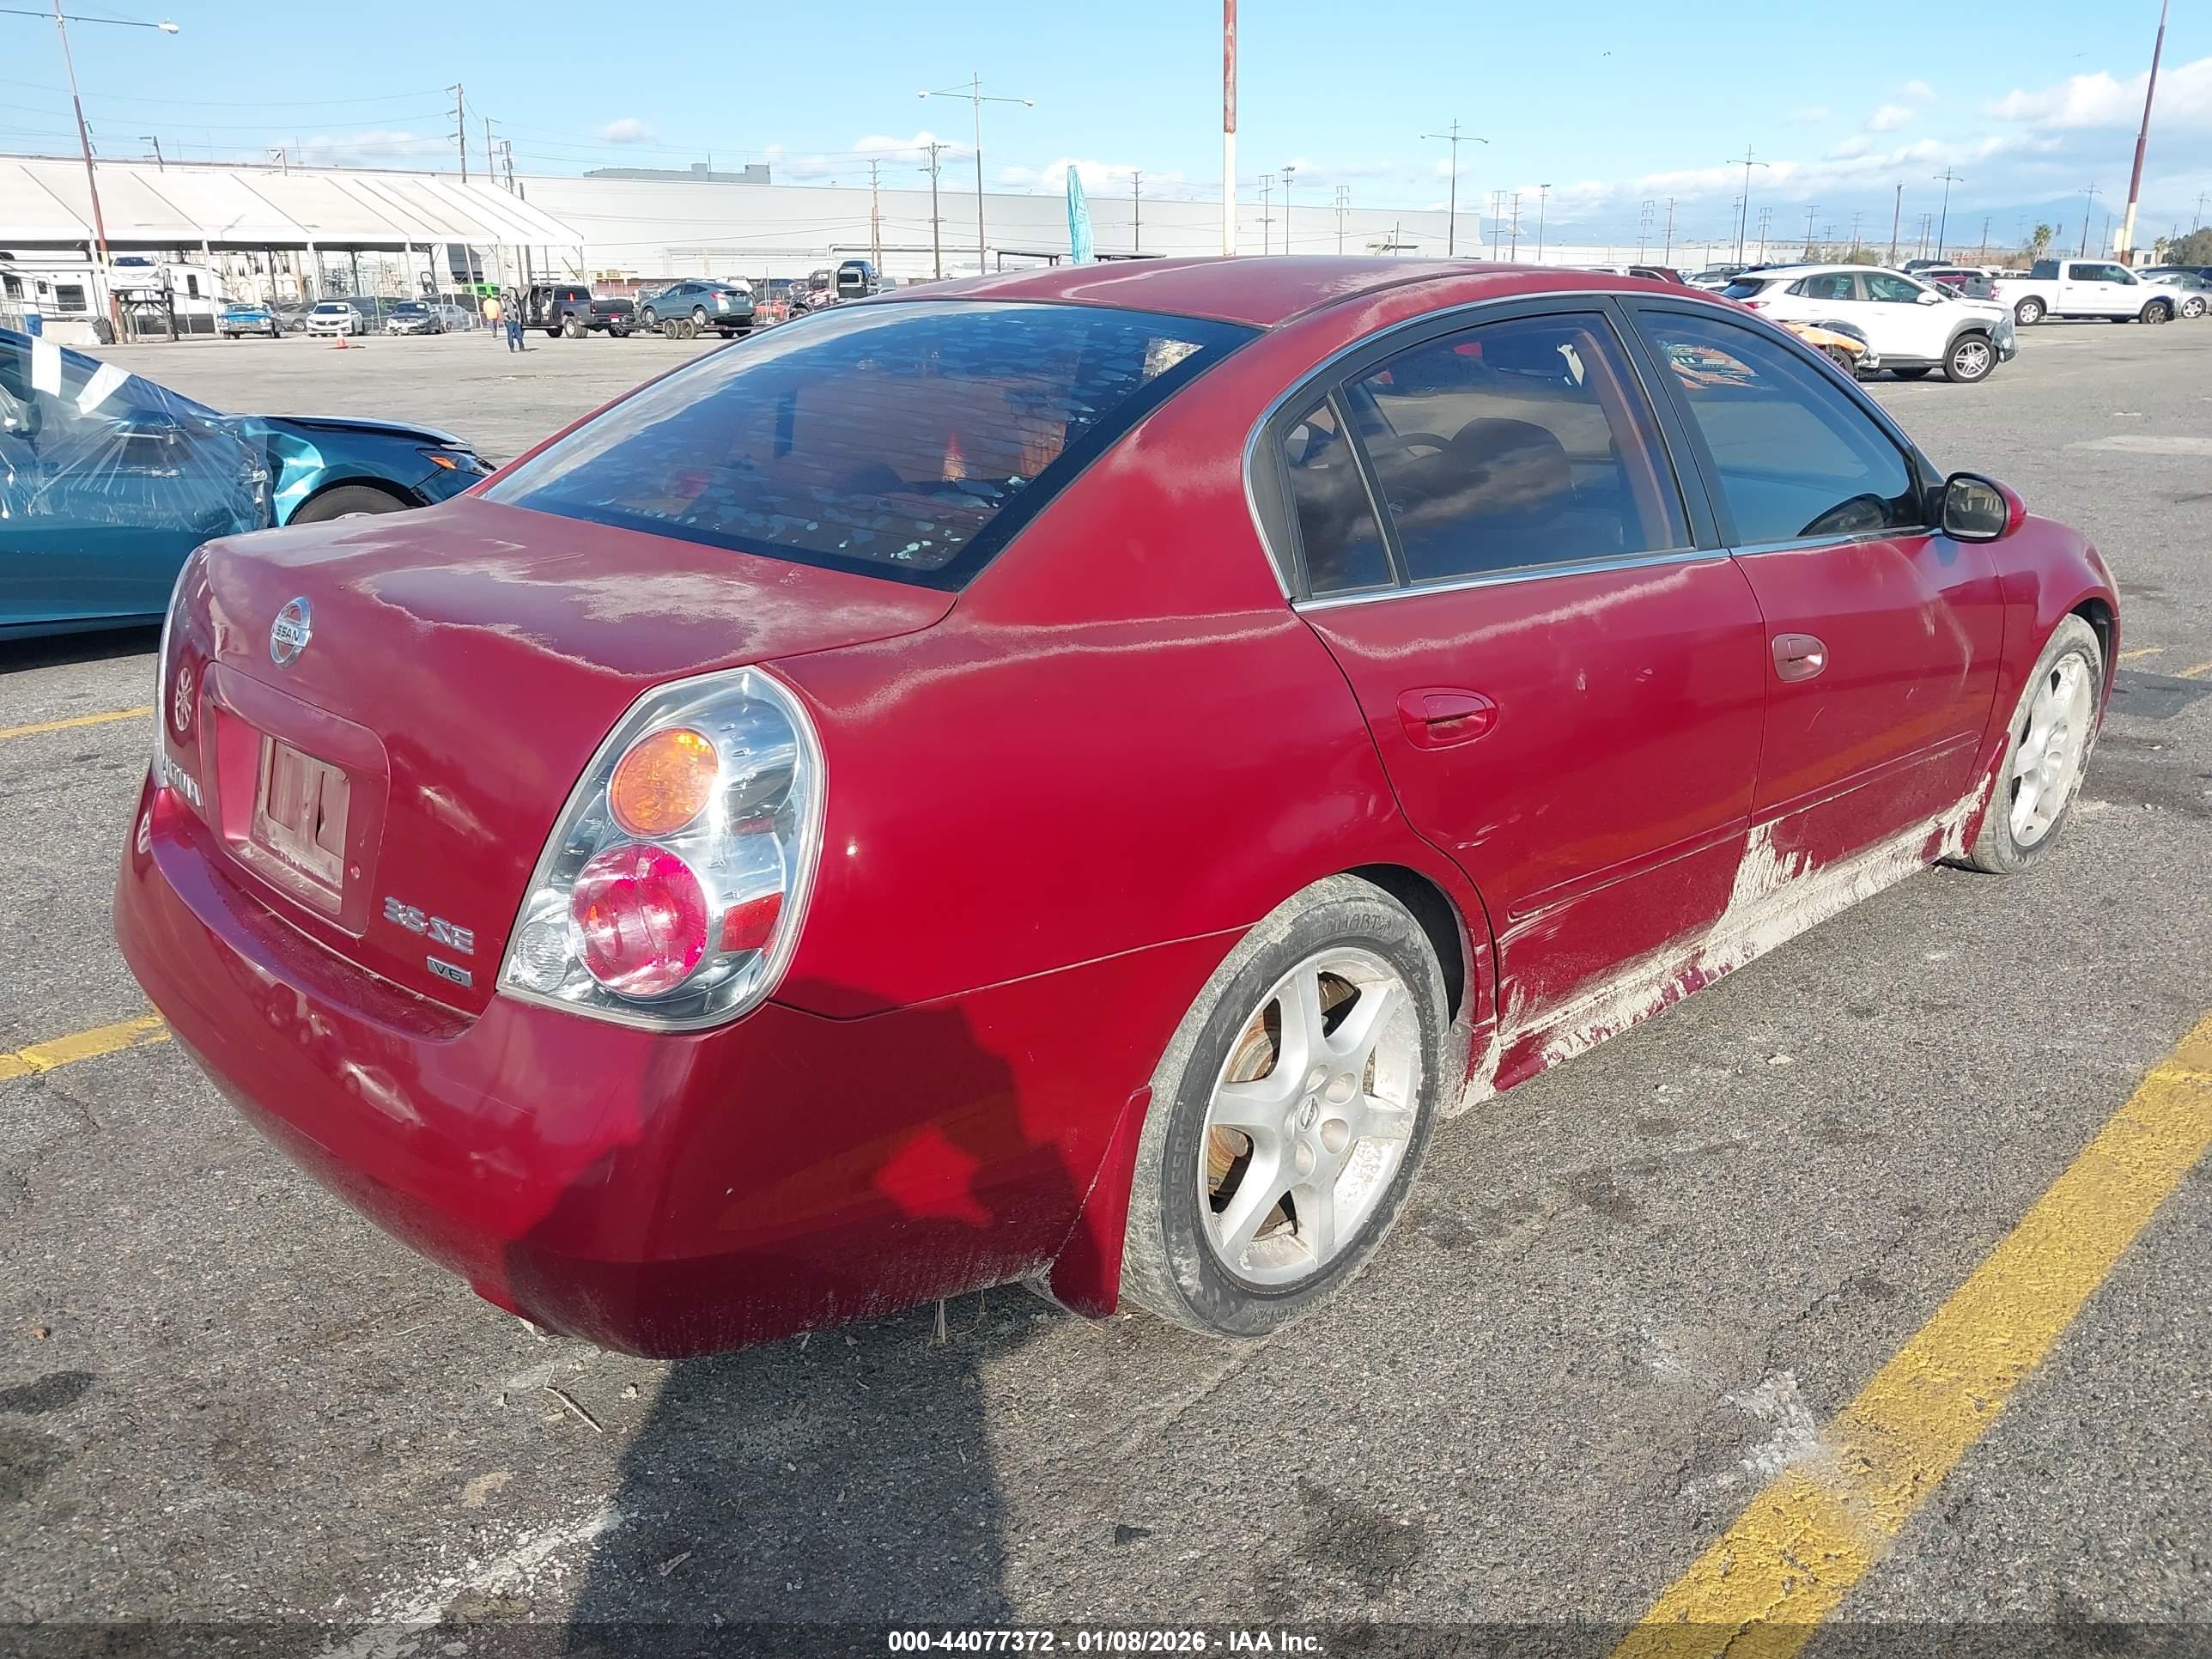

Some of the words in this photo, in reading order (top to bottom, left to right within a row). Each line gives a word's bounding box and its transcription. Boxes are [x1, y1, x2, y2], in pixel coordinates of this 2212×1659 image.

[274, 623, 301, 642] SSAN
[427, 916, 474, 956] SE
[432, 961, 462, 982] V6
